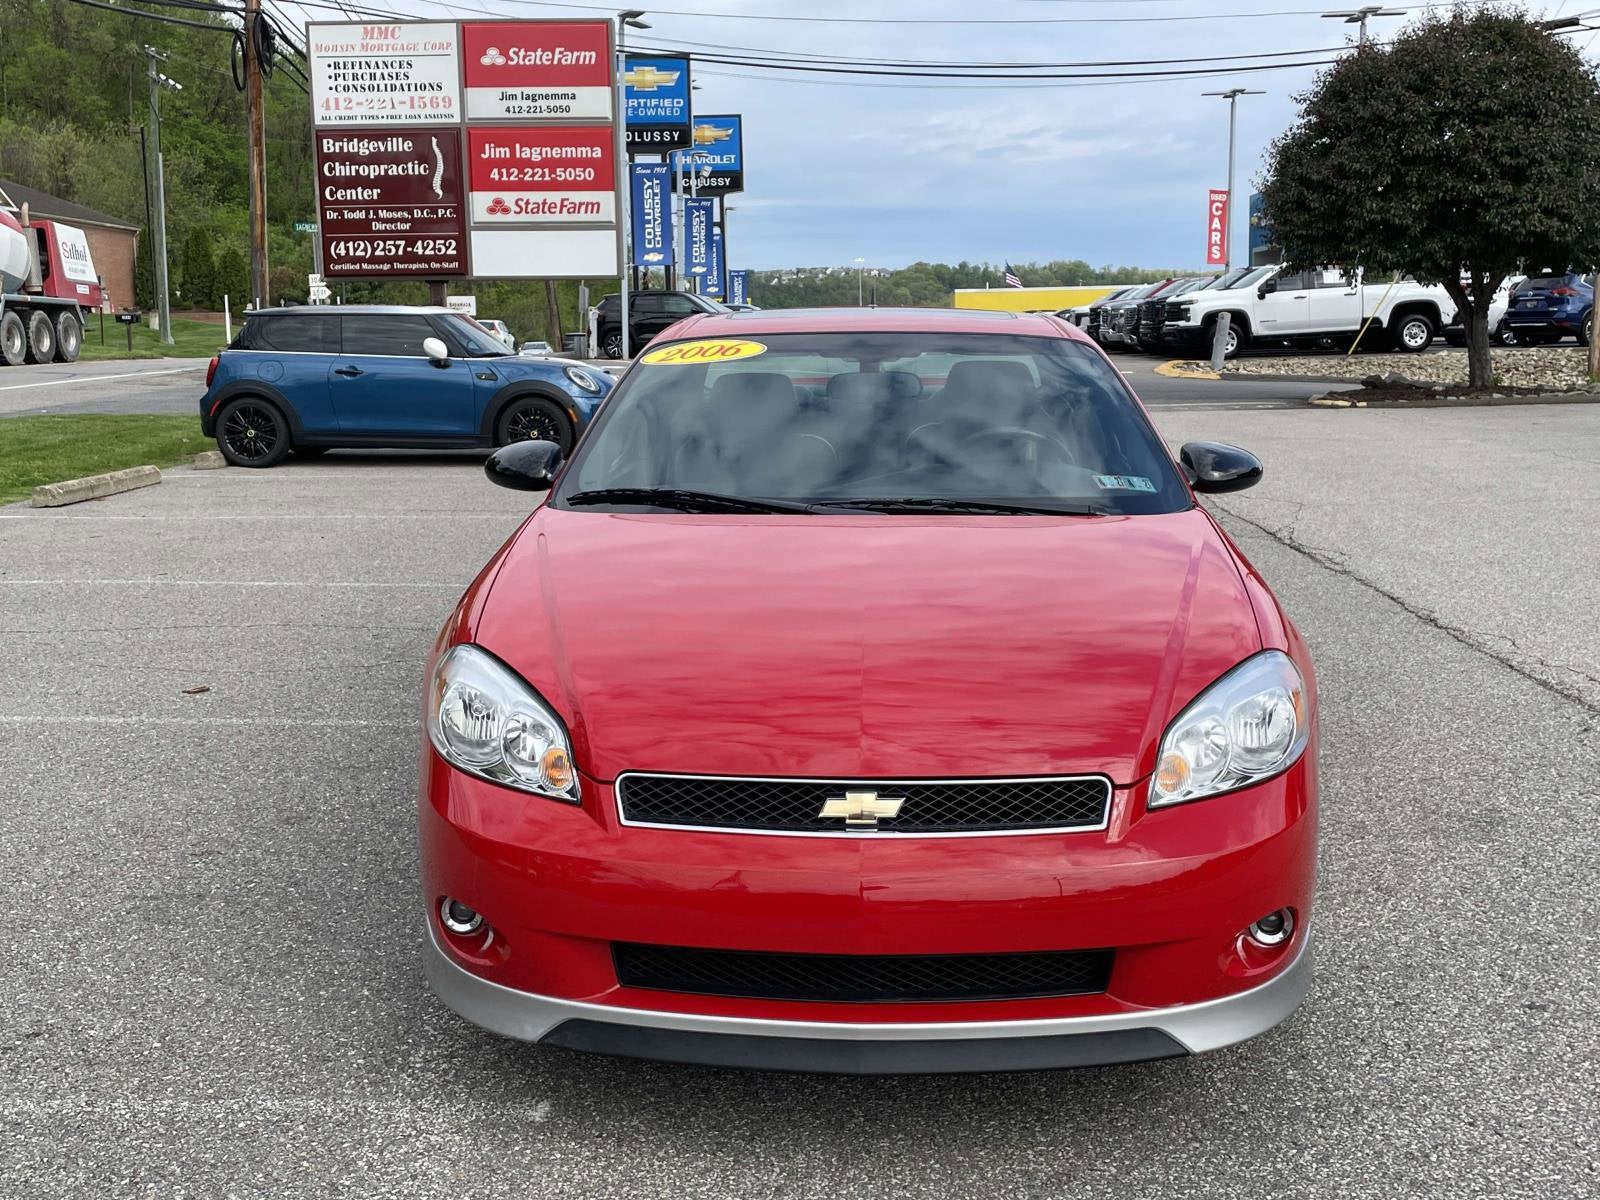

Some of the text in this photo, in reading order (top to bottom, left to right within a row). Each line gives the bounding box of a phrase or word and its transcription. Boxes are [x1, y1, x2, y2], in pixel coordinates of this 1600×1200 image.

[361, 26, 401, 40] MMC
[360, 42, 419, 52] MORTGAGE
[333, 60, 414, 70] REFINANCES
[333, 72, 410, 81] PURCHASES
[335, 82, 443, 93] CONSOLIDATIONS
[321, 96, 452, 111] 412-221-1569
[499, 91, 577, 103] Jim Iagnemma
[625, 98, 684, 107] RTIFIED
[505, 105, 571, 114] 412-221-5050
[627, 107, 681, 116] E-OWNED
[625, 131, 680, 141] OLUSSY
[322, 137, 414, 156] Bridgeville
[481, 143, 602, 161] Jim Iagnemma
[323, 160, 429, 179] Chiropractic
[490, 167, 595, 181] 412-221-5050
[325, 186, 381, 201] Center
[1211, 193, 1227, 201] USED
[326, 210, 341, 220] Dr.
[343, 210, 366, 219] Todd
[368, 209, 377, 219] J.
[379, 209, 412, 219] Moses,
[643, 177, 654, 248] COLUSSY
[653, 177, 662, 248] CHEVROLET
[371, 221, 411, 231] Director
[1211, 202, 1223, 259] CARS
[692, 209, 700, 263] COLUSSY
[330, 239, 457, 259] (412) 257-4252
[330, 261, 459, 271] Certified Massage Therapists On-Staff
[656, 342, 750, 363] 2006
